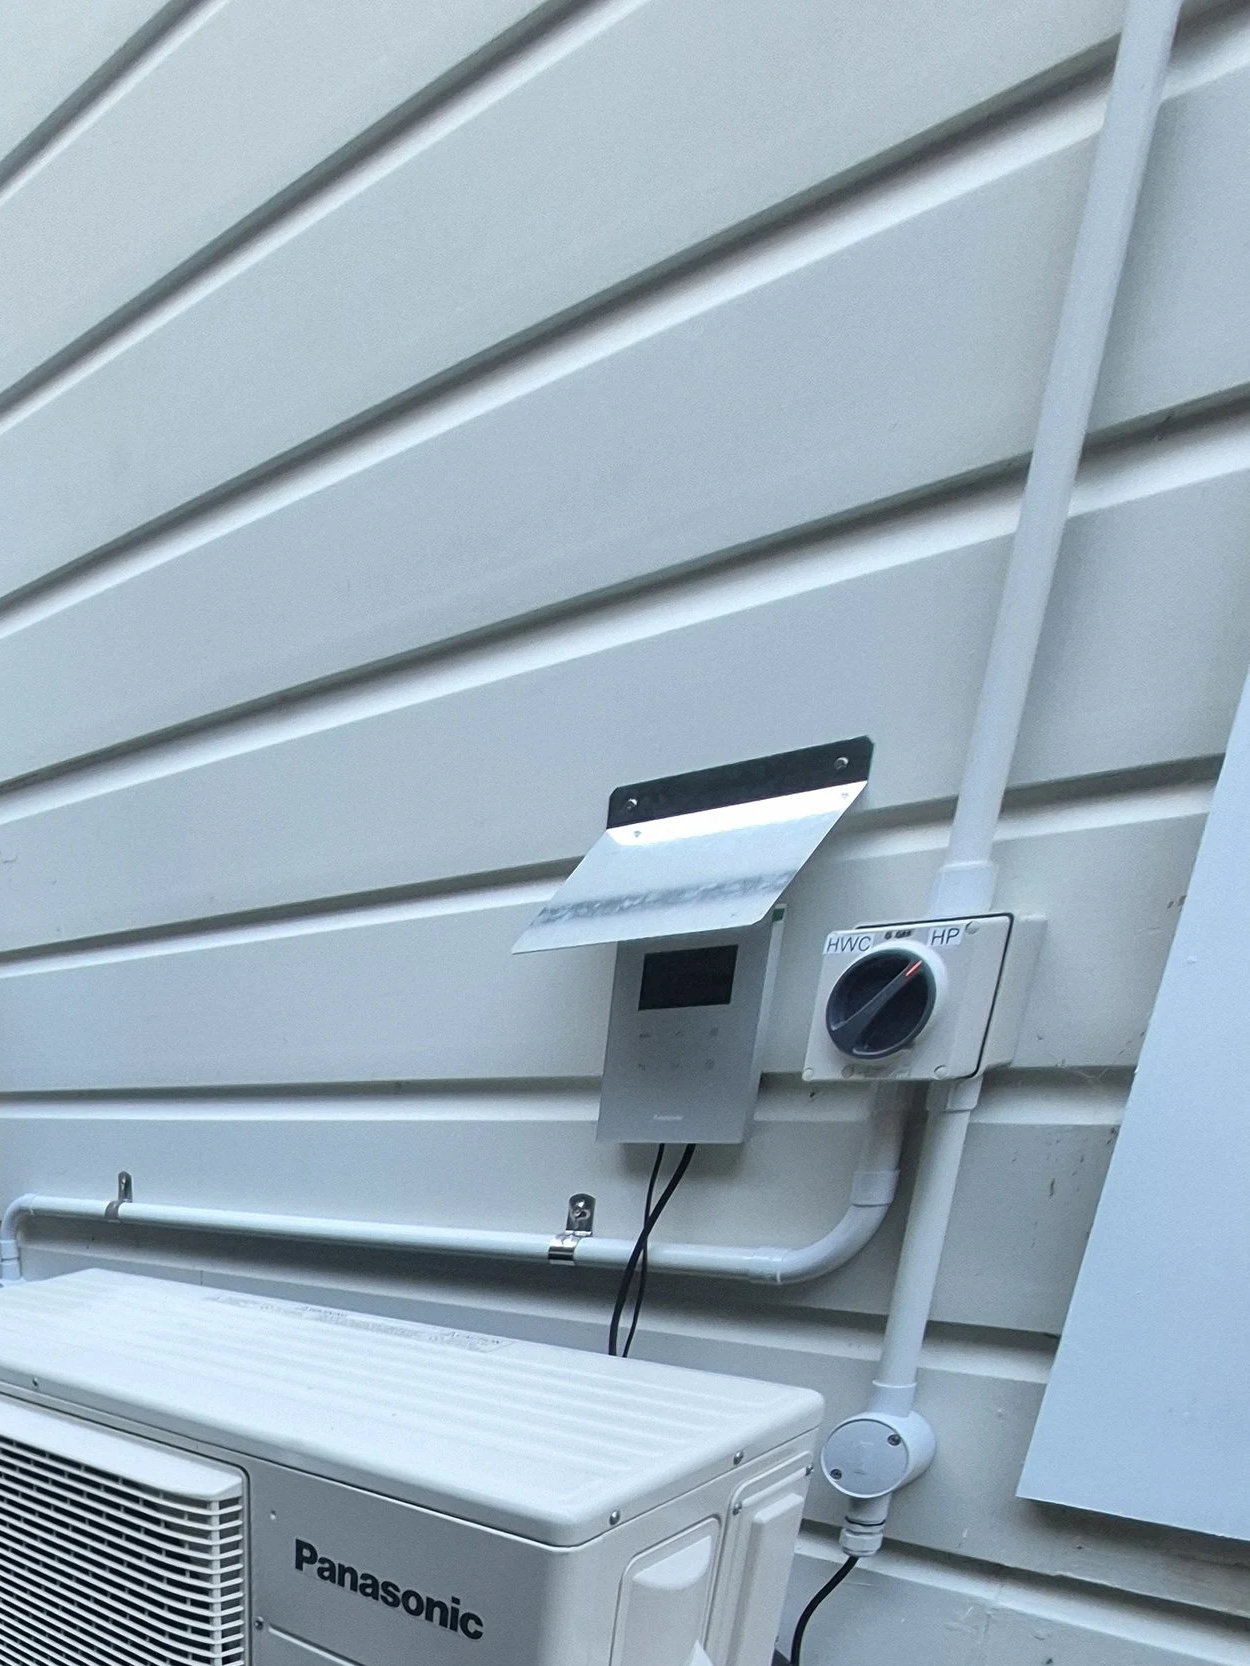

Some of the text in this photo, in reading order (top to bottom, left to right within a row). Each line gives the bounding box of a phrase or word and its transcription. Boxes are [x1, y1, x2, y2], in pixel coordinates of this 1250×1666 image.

[826, 935, 871, 953] HWC
[931, 927, 960, 945] HP
[295, 1538, 484, 1640] Panasonic
